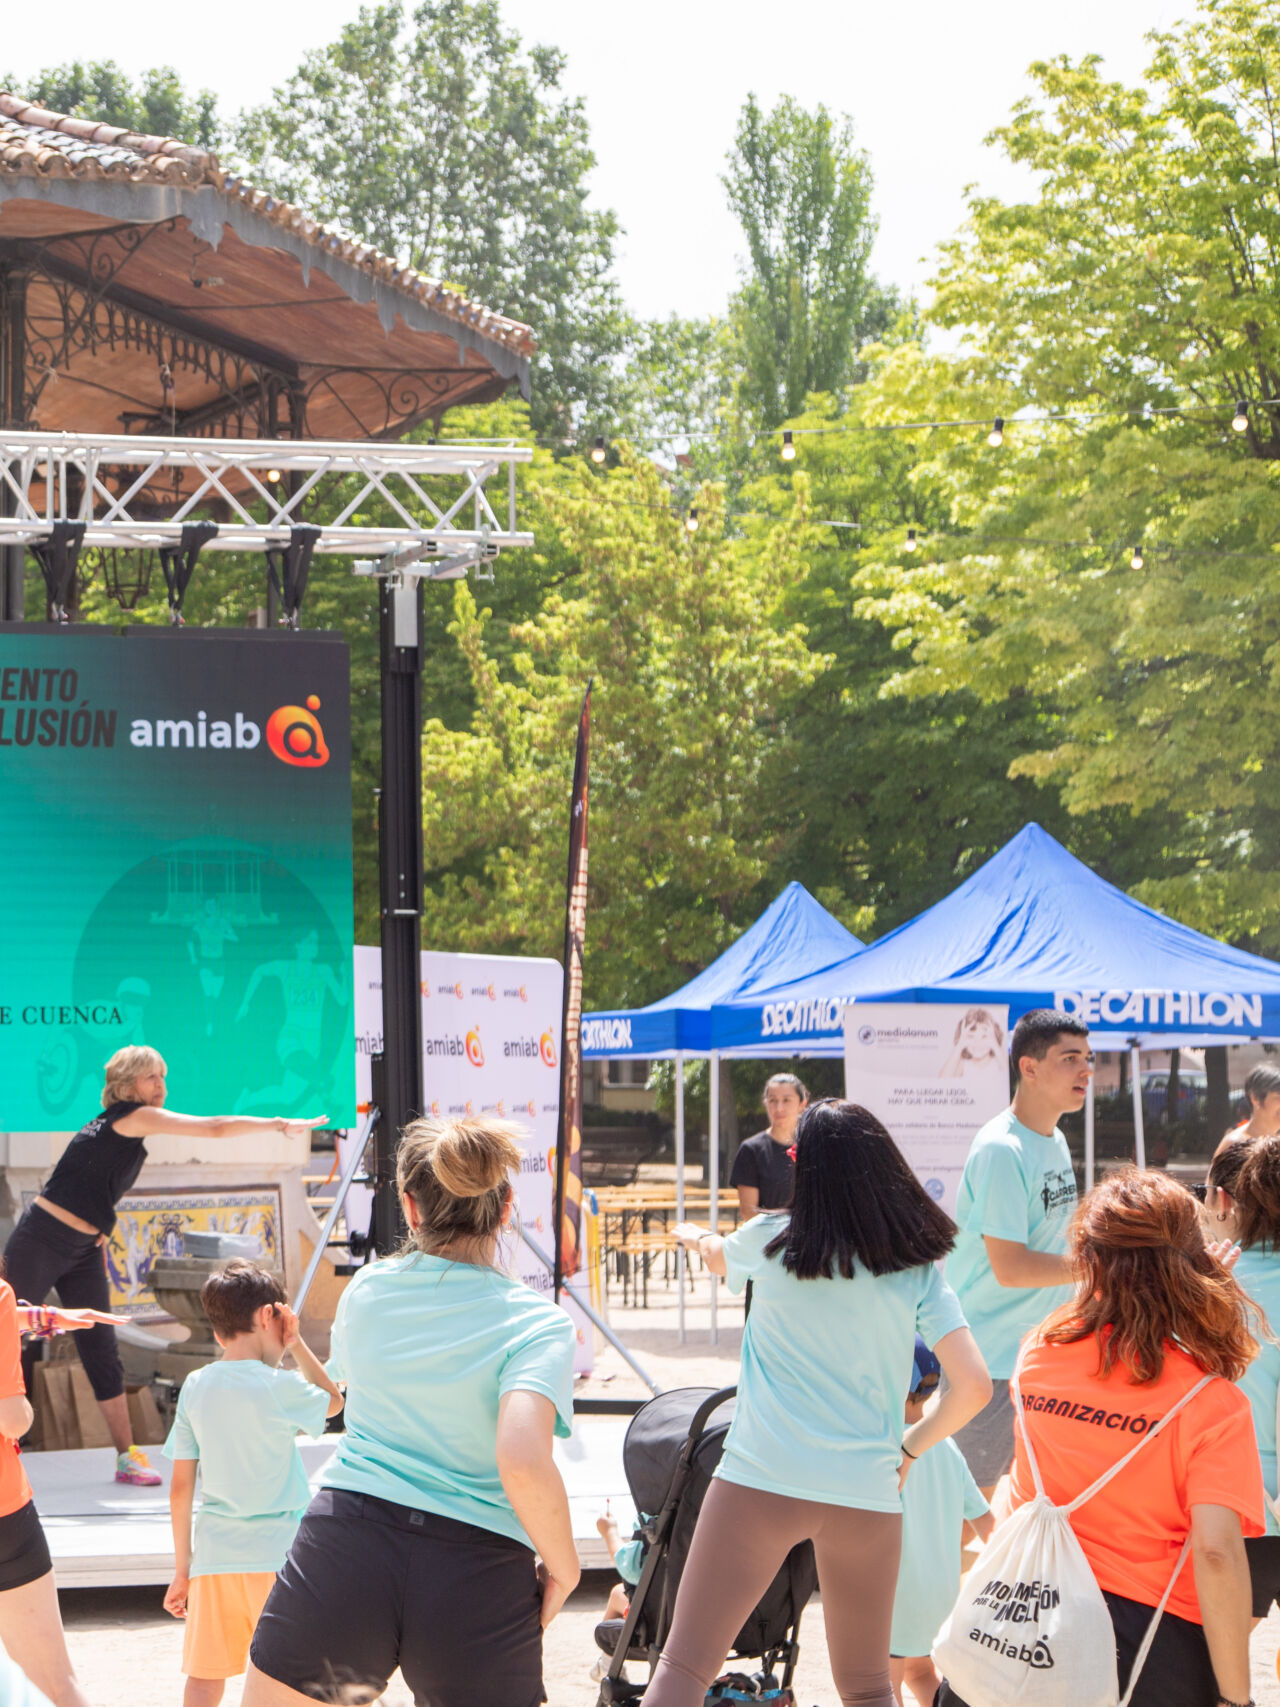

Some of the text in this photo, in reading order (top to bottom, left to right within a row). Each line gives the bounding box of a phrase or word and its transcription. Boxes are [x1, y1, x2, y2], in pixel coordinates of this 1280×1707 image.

[130, 711, 261, 749] amiab
[22, 1006, 124, 1025] CUENCA
[1054, 989, 1262, 1027] DECATHLON
[426, 1033, 464, 1057] amiab
[581, 1019, 633, 1050] CATHLON
[503, 1036, 539, 1057] amiab
[893, 1088, 914, 1096] PARA
[521, 1152, 547, 1174] miab
[972, 1597, 989, 1606] POR
[989, 1600, 1000, 1611] LA
[969, 1627, 1032, 1662] amiab
